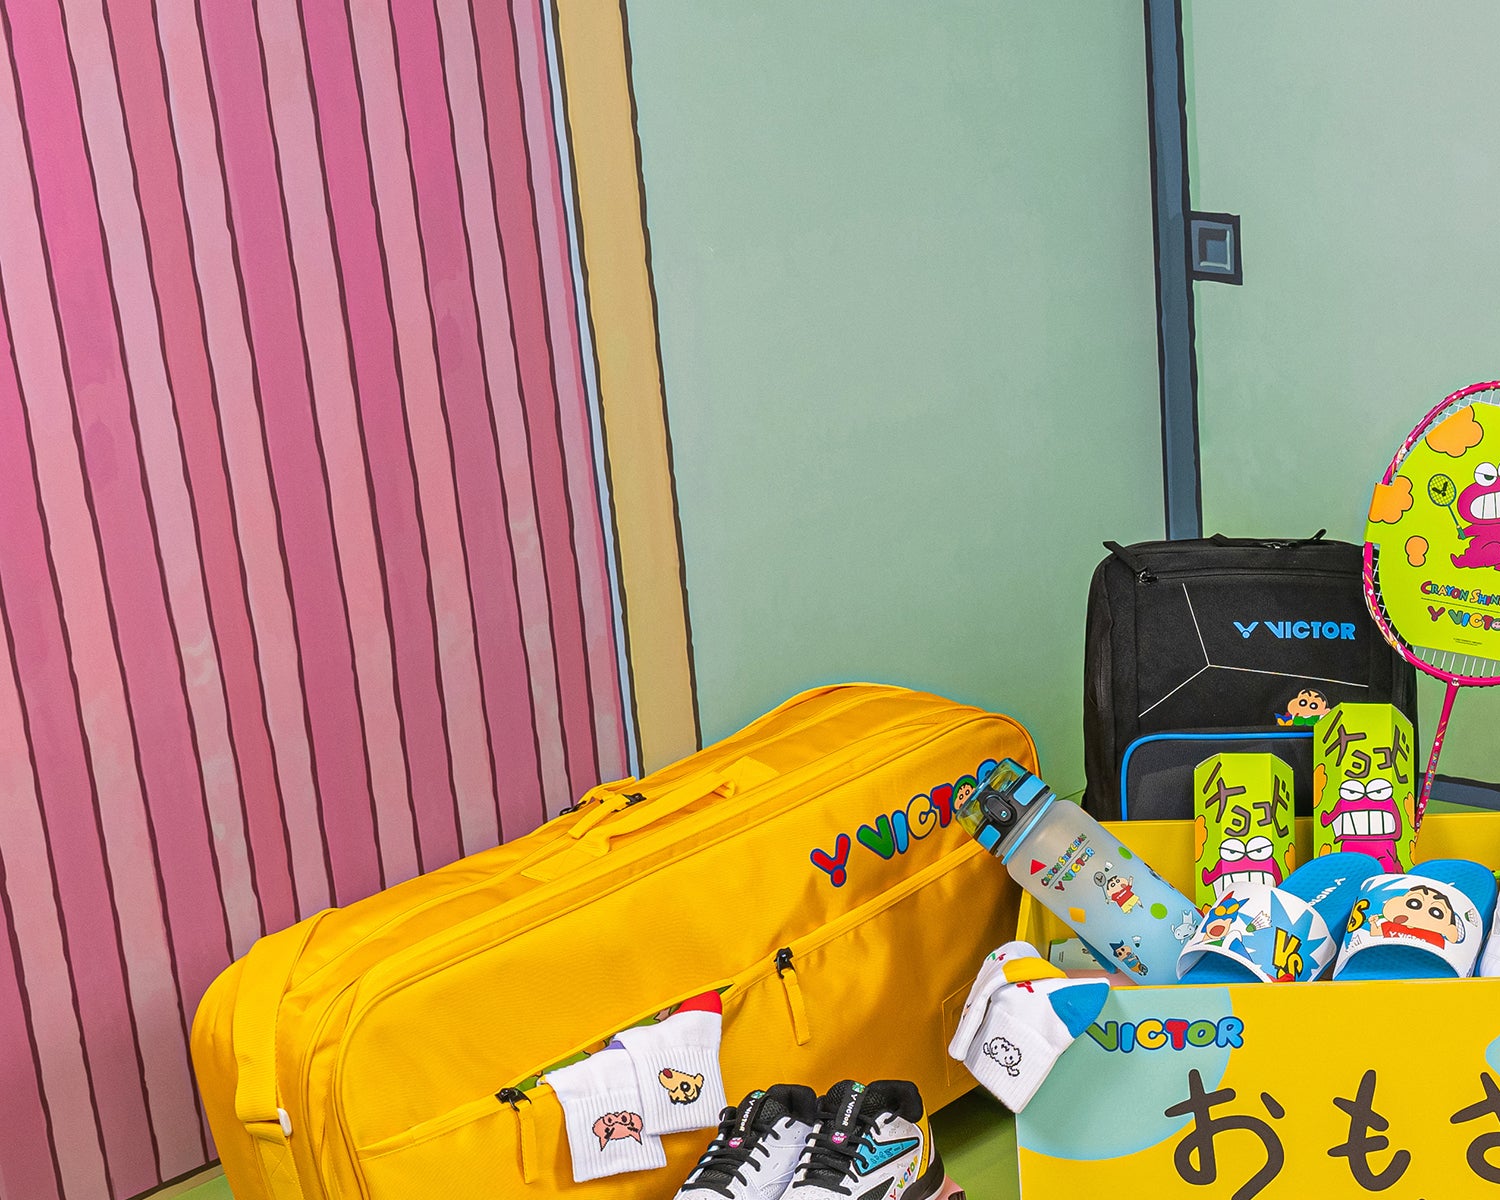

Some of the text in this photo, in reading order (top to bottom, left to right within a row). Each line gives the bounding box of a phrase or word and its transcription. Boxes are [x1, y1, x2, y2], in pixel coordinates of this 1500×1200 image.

[1421, 580, 1469, 602] CRAYON
[1264, 621, 1356, 641] VICTOR
[1062, 847, 1095, 881] VICTOR
[1085, 1015, 1245, 1053] VICTOR
[738, 1106, 752, 1132] VICTOR
[841, 1101, 856, 1127] VICTOR
